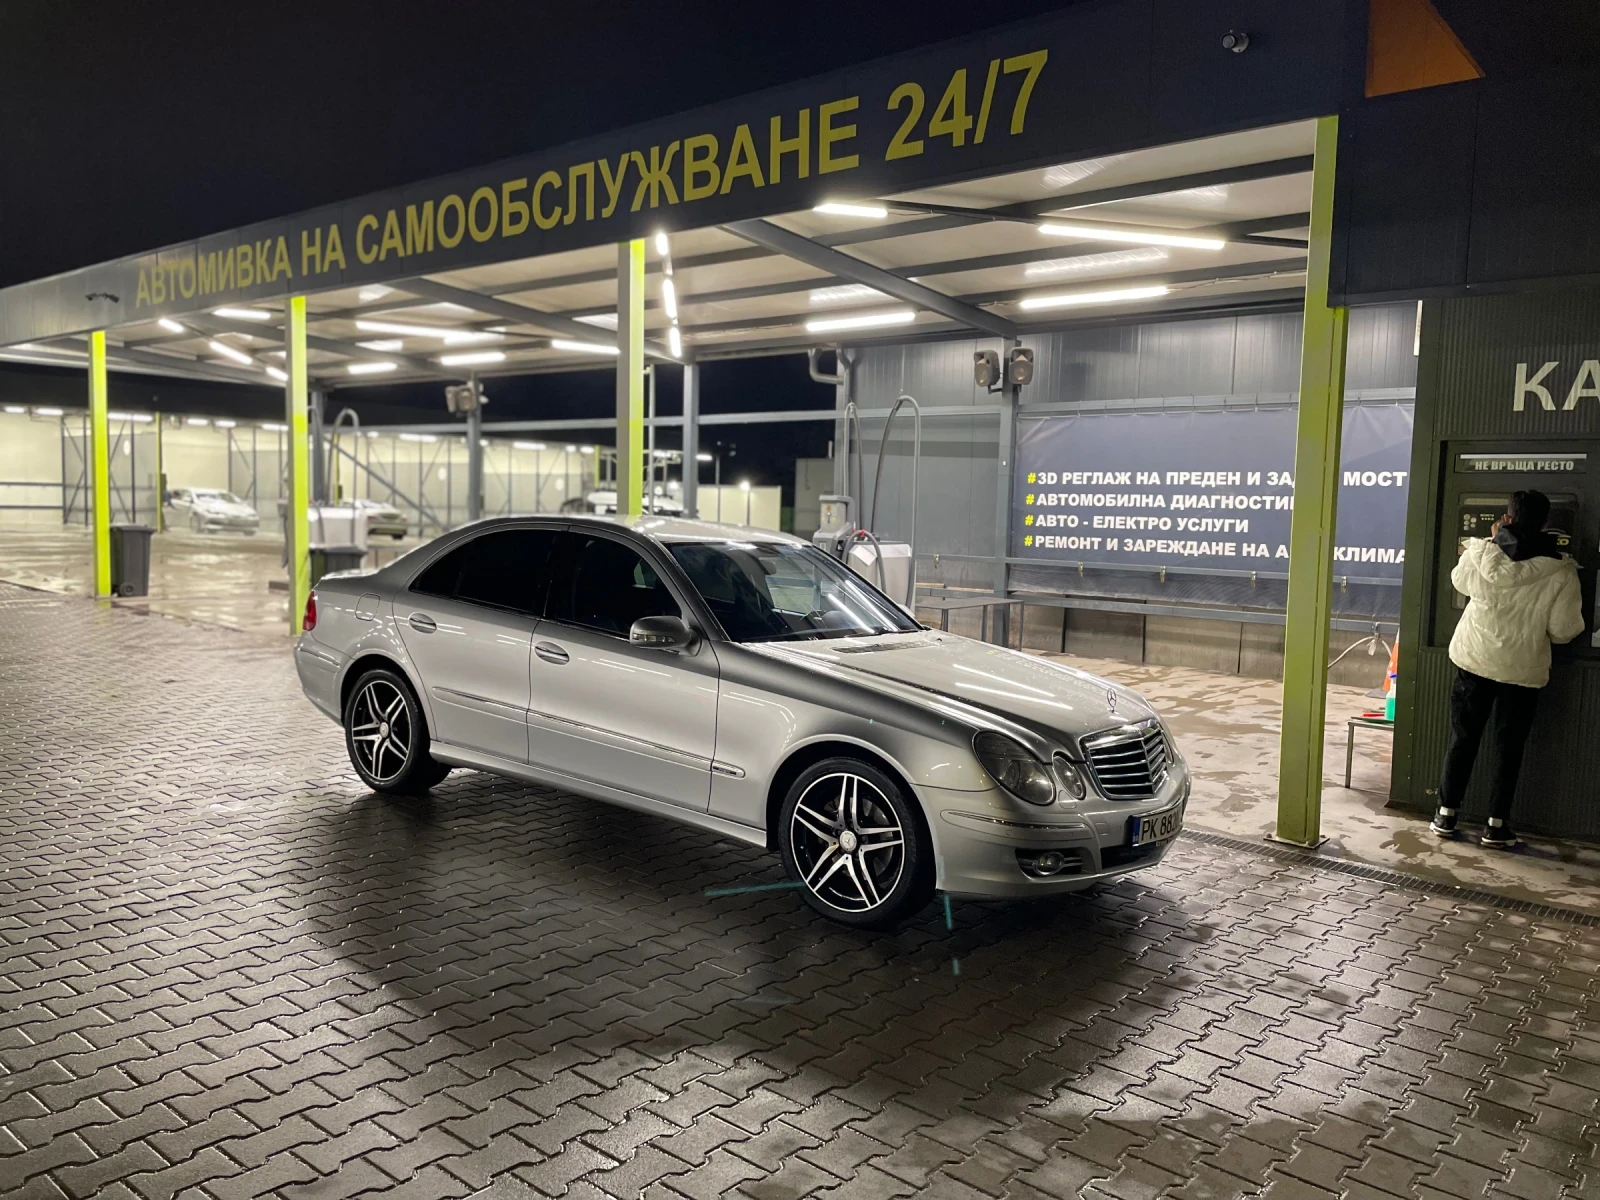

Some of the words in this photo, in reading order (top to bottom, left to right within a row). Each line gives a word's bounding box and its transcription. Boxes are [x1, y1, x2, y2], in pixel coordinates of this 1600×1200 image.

[135, 235, 293, 308] АВТОМИВКА
[302, 223, 347, 276] НА
[355, 95, 860, 265] САМООБСЛУЖВАНЕ
[885, 48, 1049, 161] 24/7
[1475, 461, 1489, 470] НЕ
[1490, 461, 1535, 471] ВРЪЩА
[1537, 461, 1575, 470] РЕСТО
[1062, 471, 1132, 485] РЕГЛАЖ
[1136, 471, 1161, 485] НА
[1166, 471, 1241, 488] ПРЕДЕН
[1247, 471, 1261, 486] И
[1266, 471, 1295, 489] ЗА
[1343, 471, 1408, 487] МОСТ
[1092, 515, 1172, 531] ЕЛЕКТРО
[1177, 517, 1249, 533] УСЛУГИ
[1106, 538, 1119, 551] И
[1123, 539, 1237, 557] ЗАРЕЖДАНЕ
[1242, 543, 1270, 558] НА
